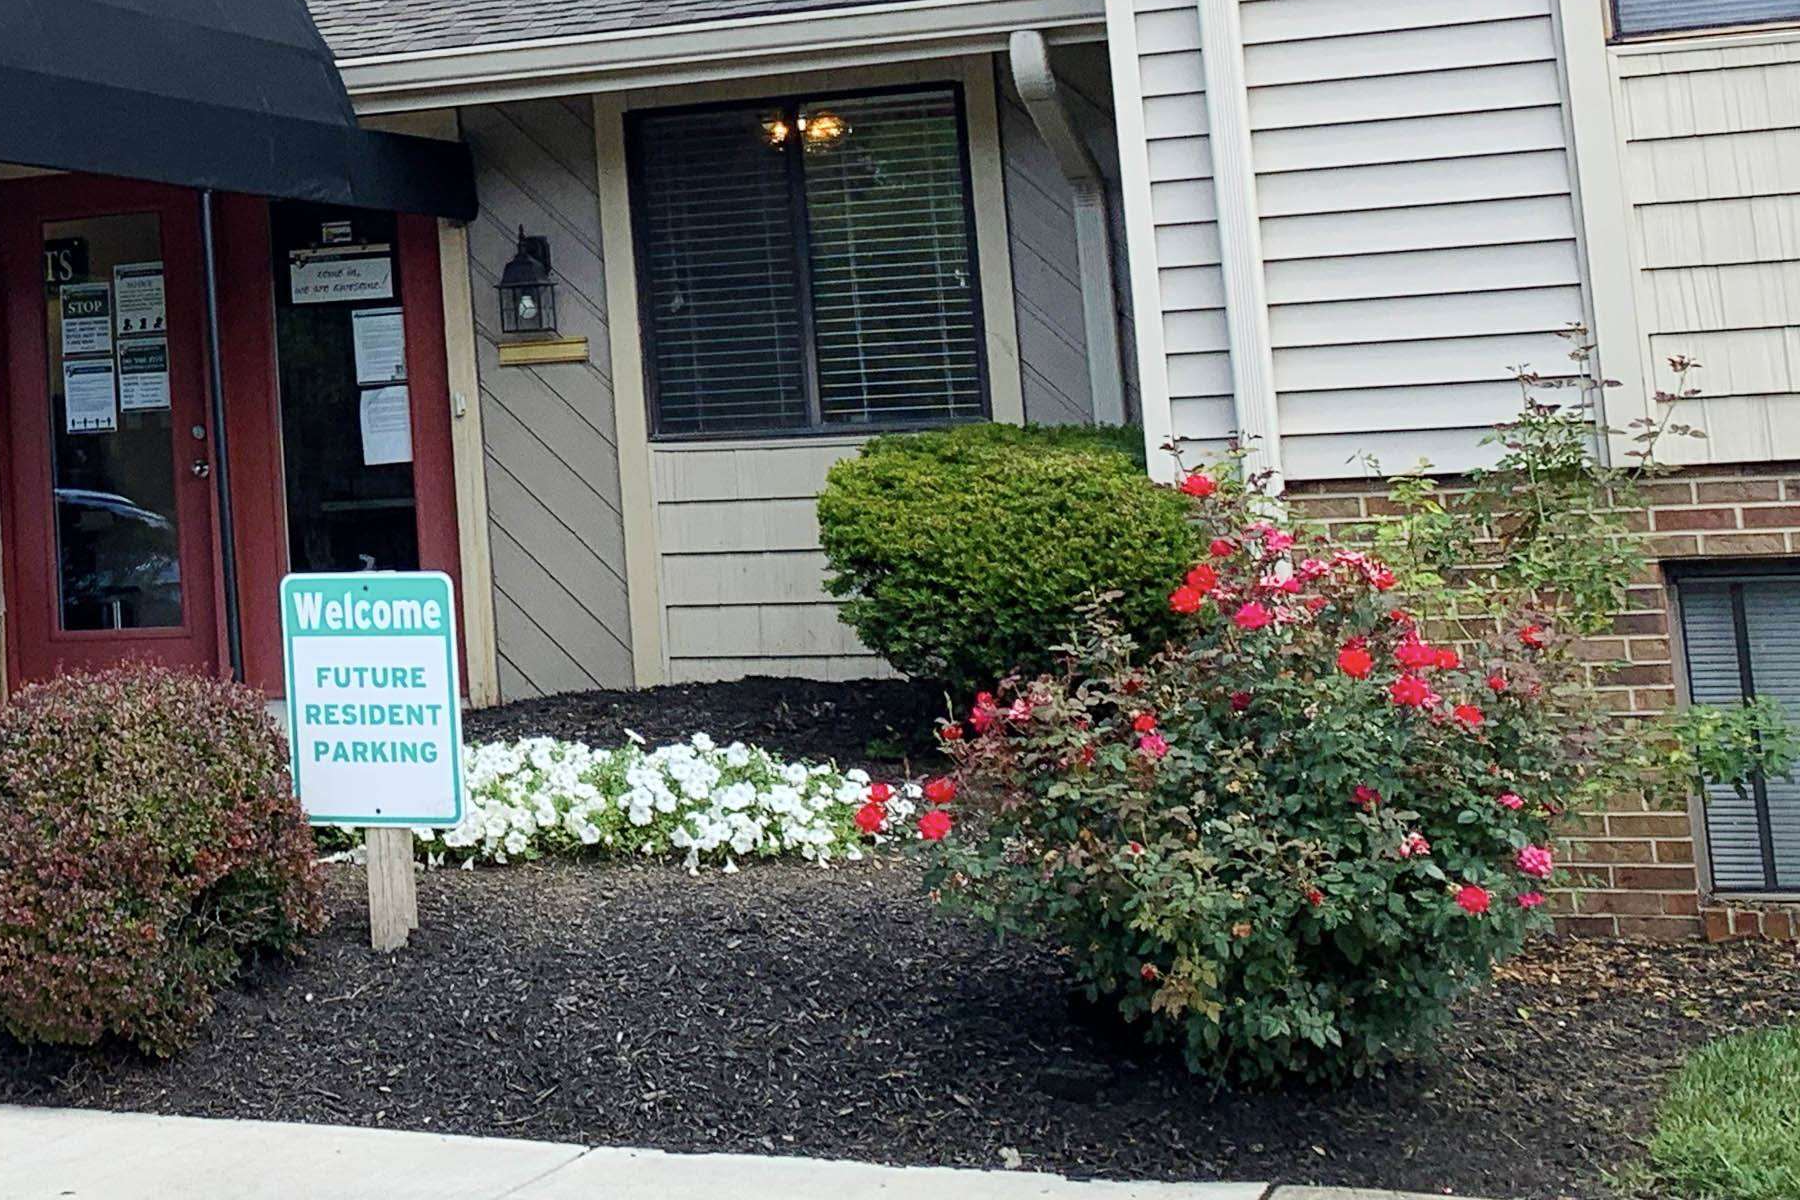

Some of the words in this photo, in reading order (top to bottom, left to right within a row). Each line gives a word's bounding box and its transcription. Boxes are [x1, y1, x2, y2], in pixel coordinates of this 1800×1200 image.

[68, 300, 102, 314] STOP
[293, 591, 442, 630] Welcome
[316, 666, 427, 688] FUTURE
[305, 704, 442, 726] RESIDENT
[313, 741, 438, 763] PARKING
